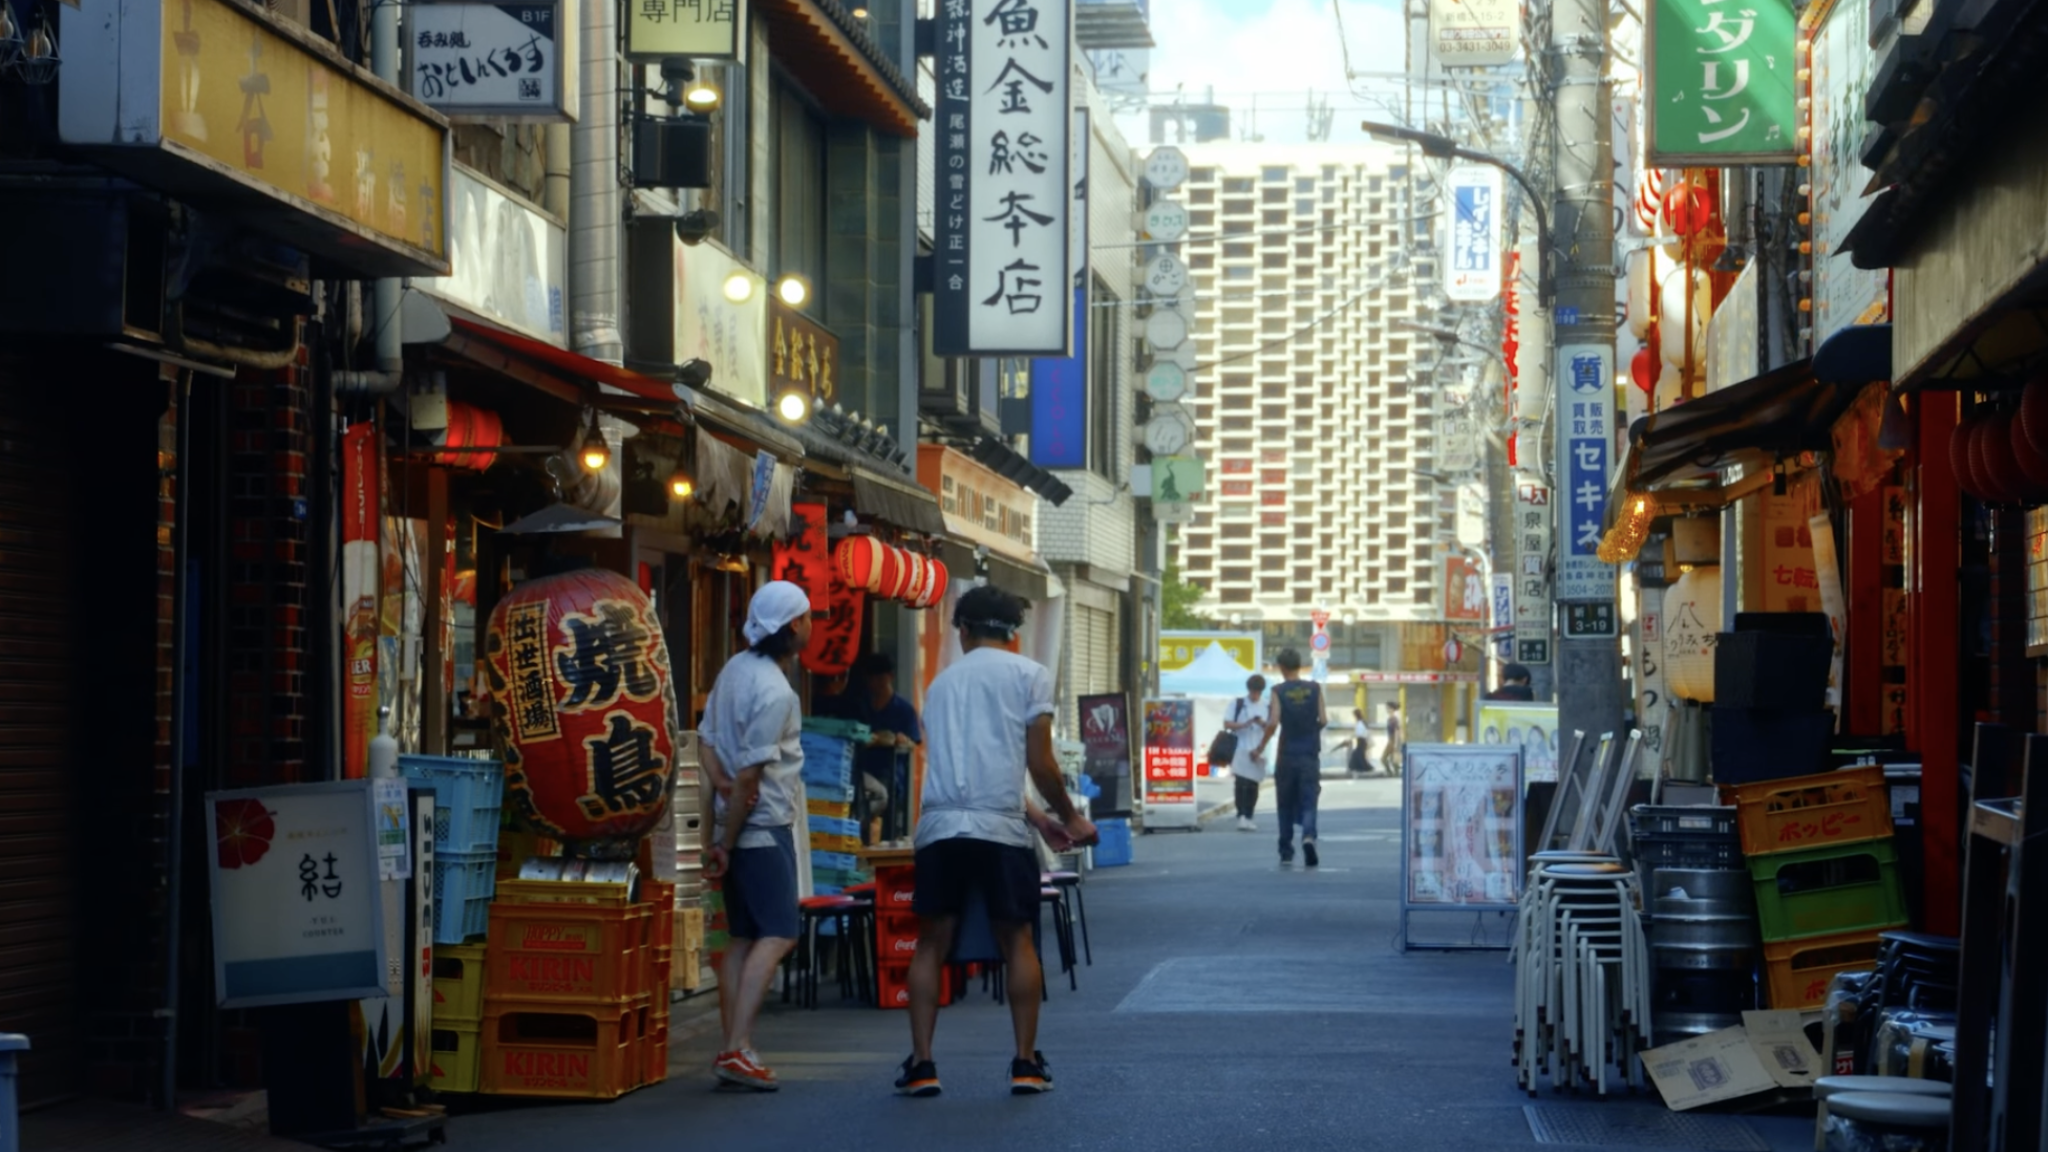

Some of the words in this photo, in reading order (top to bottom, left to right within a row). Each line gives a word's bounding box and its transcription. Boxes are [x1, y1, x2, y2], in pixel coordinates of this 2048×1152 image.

[521, 10, 551, 22] B1F
[640, 0, 733, 23] 専門店
[417, 30, 471, 48] 呑み処
[1694, 3, 1755, 143] ダリン
[981, 0, 1055, 316] 魚金総本店
[948, 113, 966, 291] 尾瀬の雪どけ正一合
[1571, 356, 1602, 391] 質
[1575, 442, 1602, 546] セキネ
[1525, 512, 1543, 597] 泉屋質店
[1772, 564, 1819, 589] 七転
[1576, 620, 1606, 631] 3-19
[513, 612, 551, 731] 出世酒場
[557, 604, 664, 816] 焼鳥
[1779, 812, 1861, 841] ホッピー
[299, 852, 343, 901] 結
[302, 927, 345, 938] COUNTER
[508, 956, 594, 982] KIRIN
[528, 982, 574, 992] キリンビール
[504, 1051, 589, 1078] KIRIN
[524, 1077, 568, 1088] キリンビール
